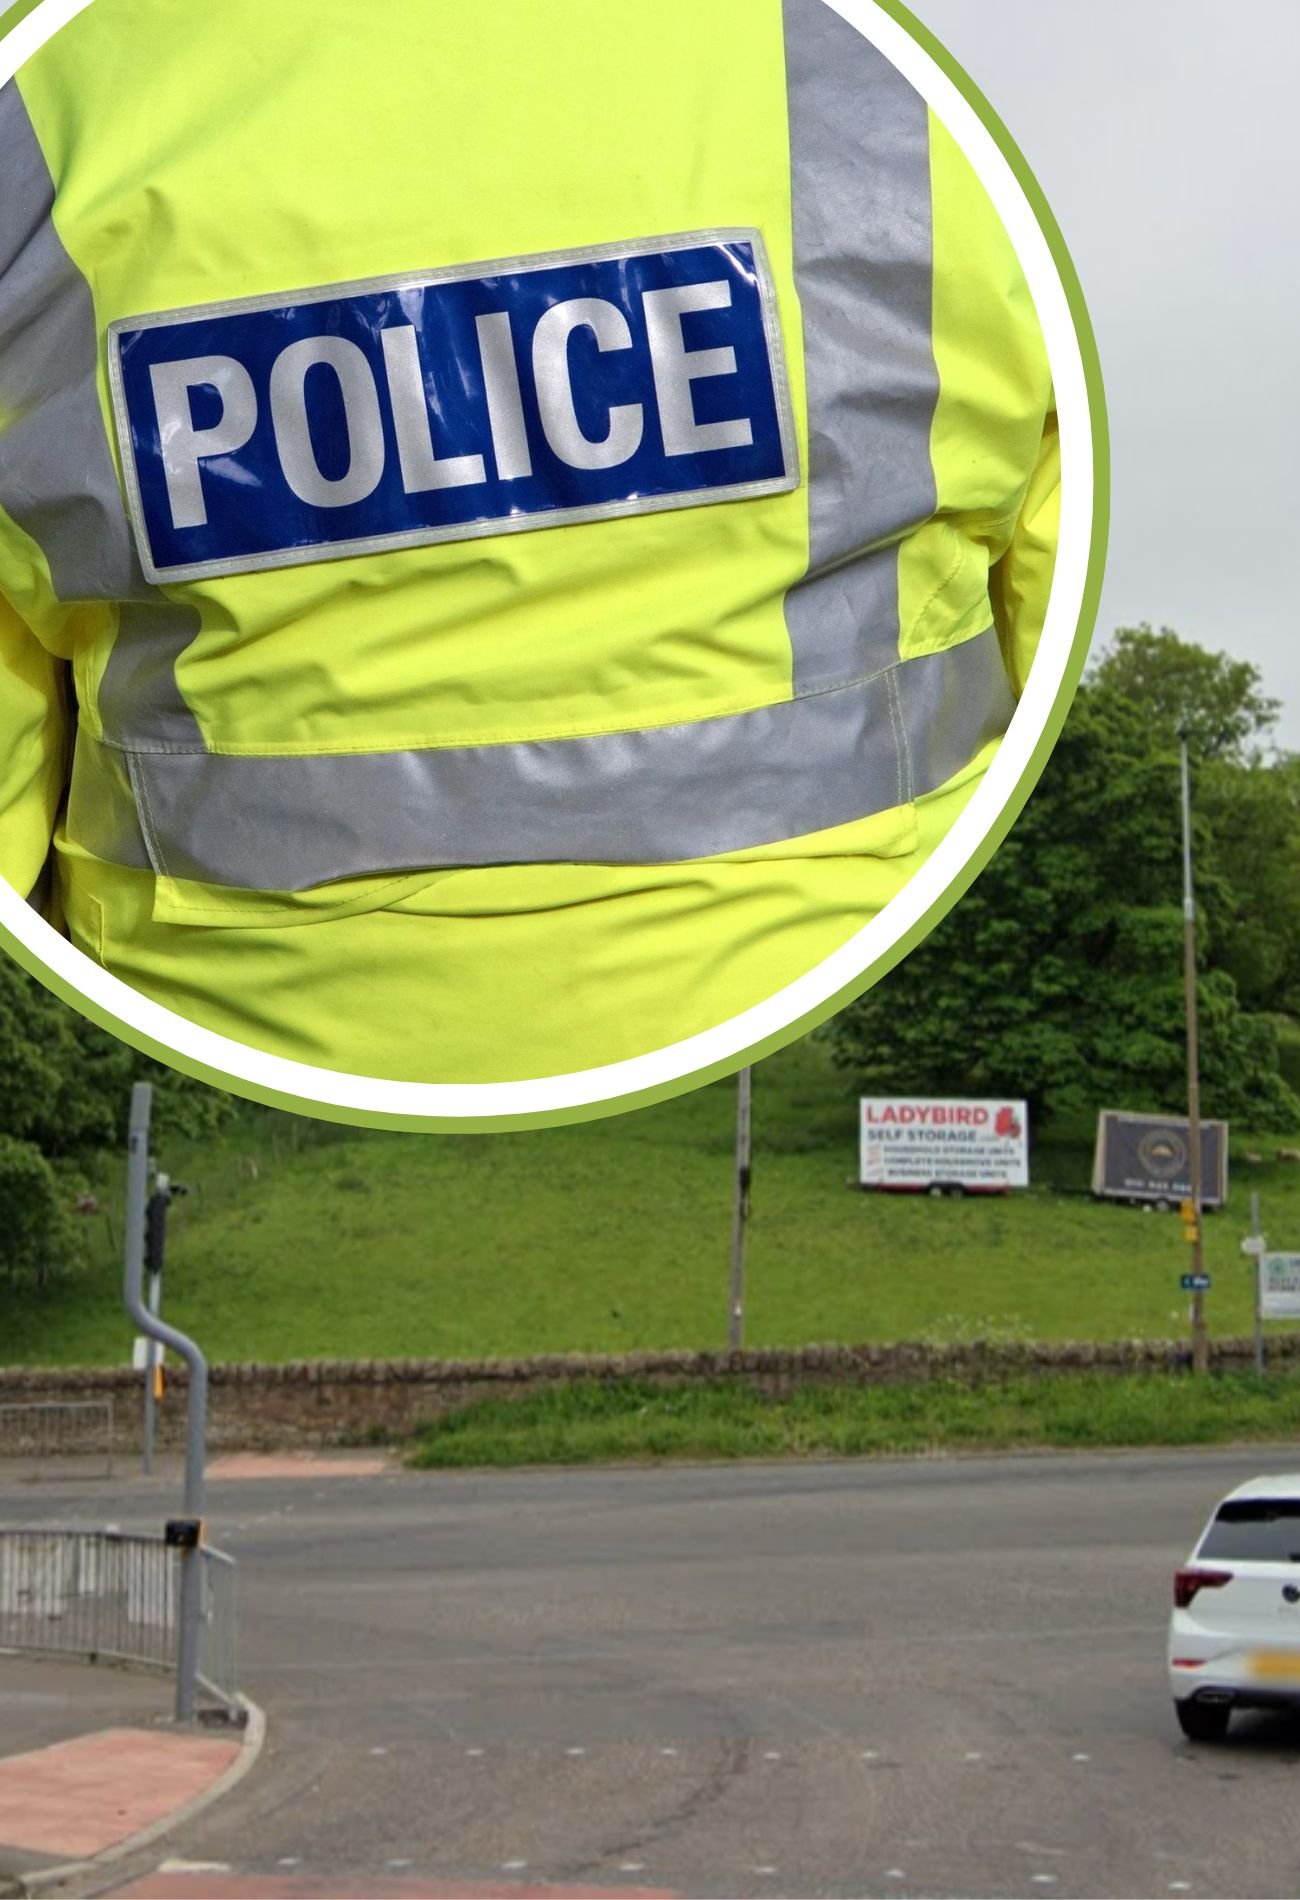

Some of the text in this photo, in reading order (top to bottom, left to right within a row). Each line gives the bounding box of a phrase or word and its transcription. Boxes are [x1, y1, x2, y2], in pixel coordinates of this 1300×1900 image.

[149, 278, 754, 529] POLICE
[866, 1104, 989, 1125] LADYBIRD
[867, 1129, 904, 1142] SELF
[907, 1129, 977, 1142] STORAGE
